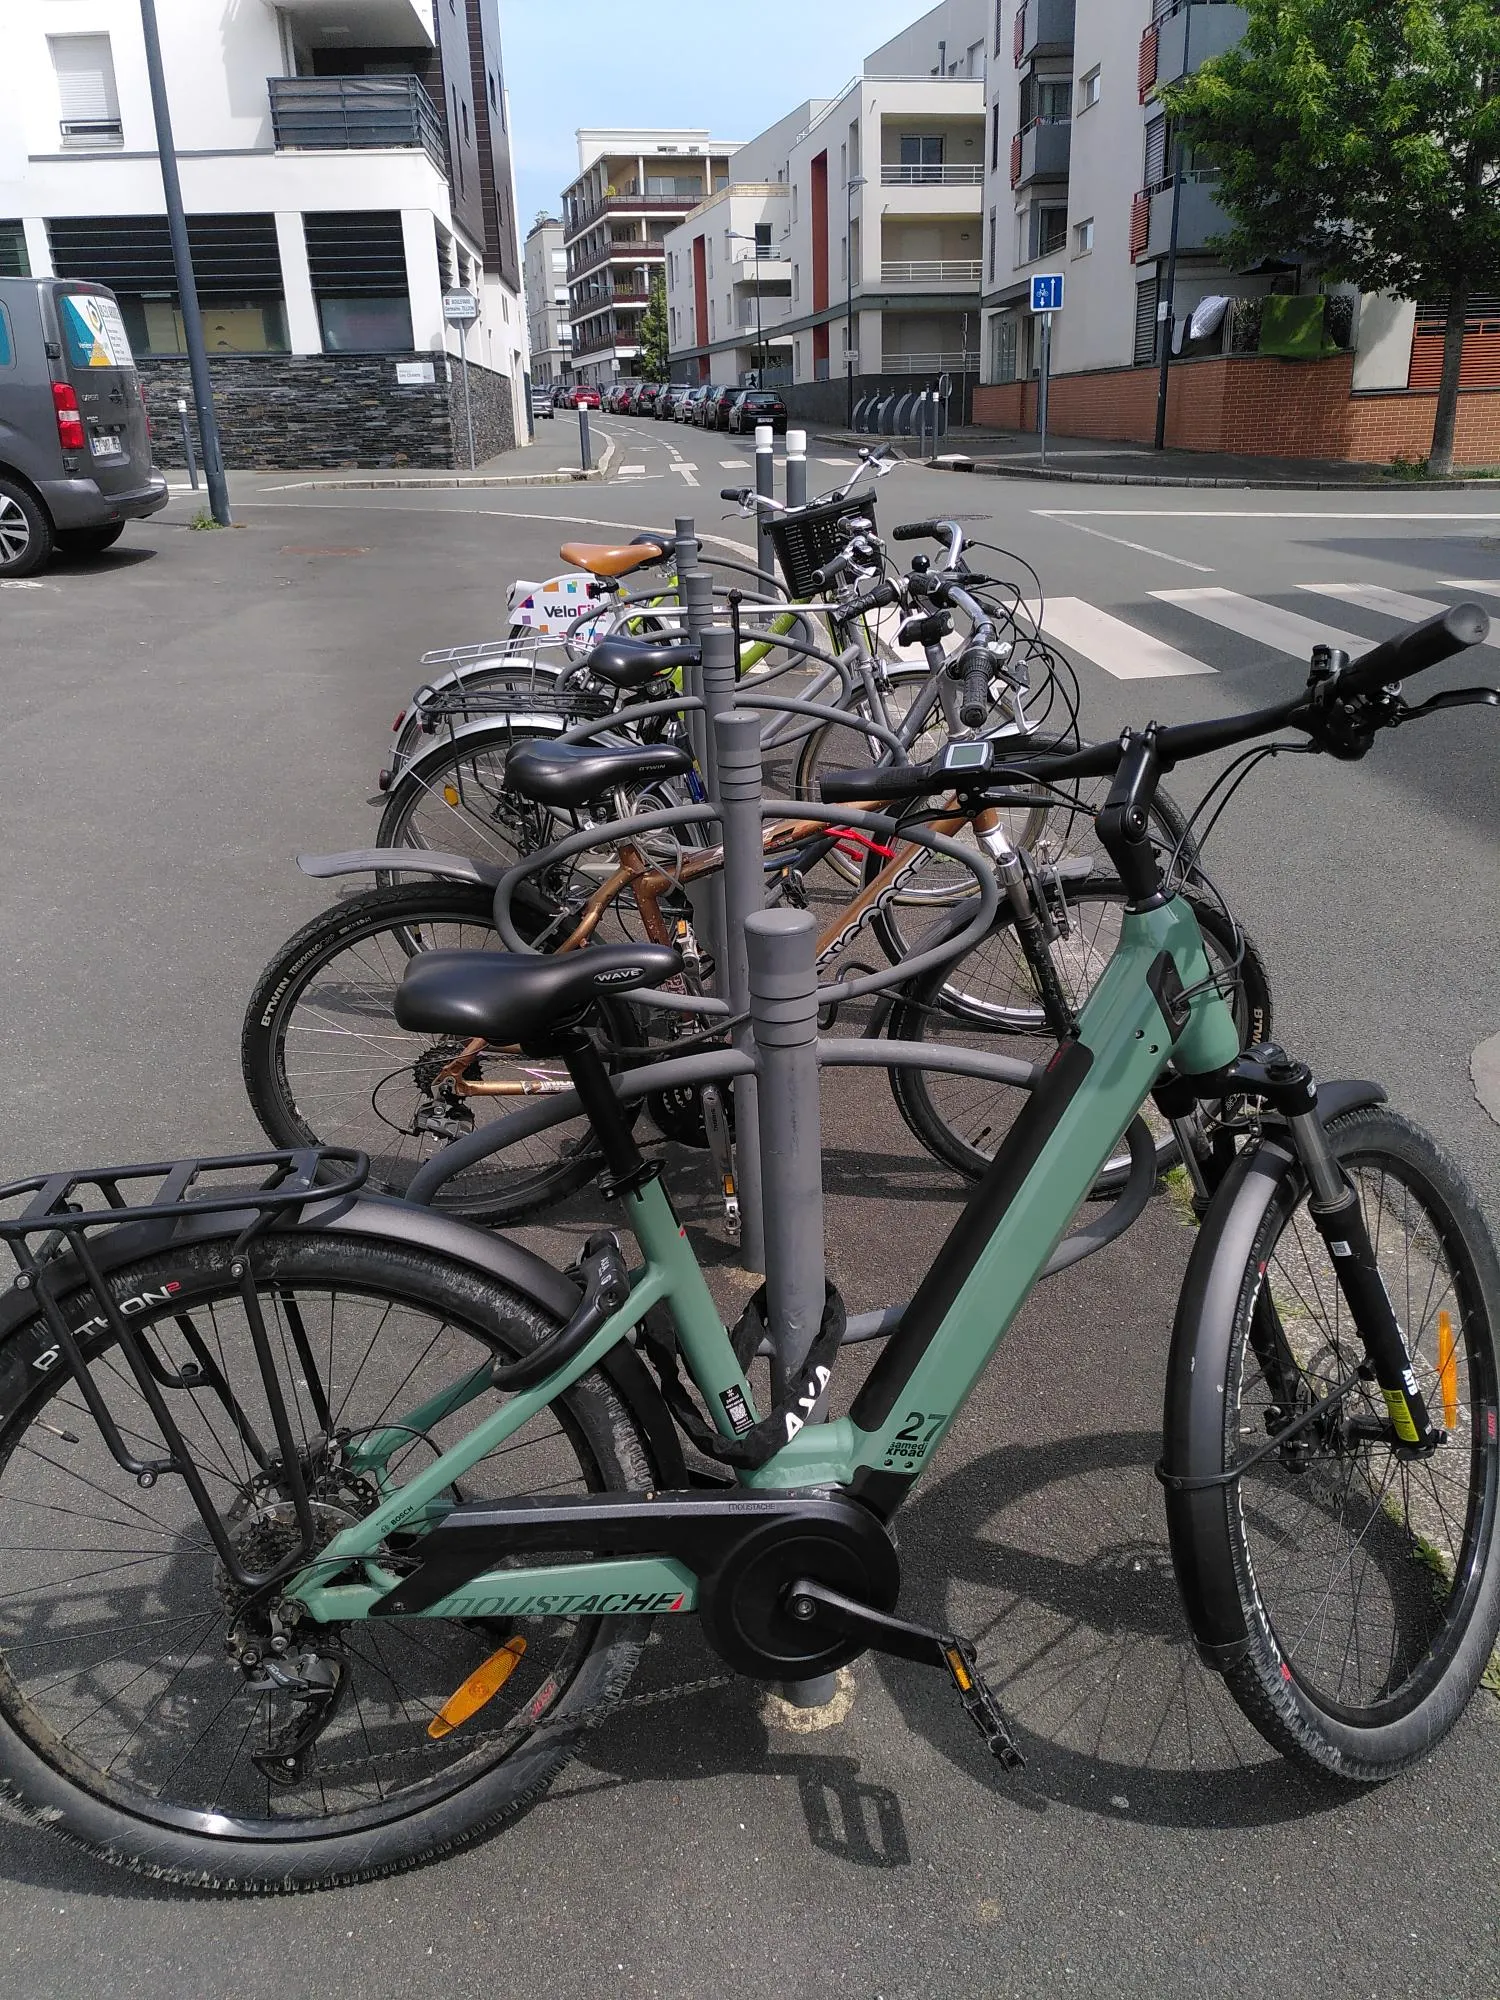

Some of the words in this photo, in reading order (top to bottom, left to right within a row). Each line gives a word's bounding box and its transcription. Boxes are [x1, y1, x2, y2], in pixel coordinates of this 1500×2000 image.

[598, 969, 641, 982] WAVE
[1402, 1368, 1418, 1396] ATB
[895, 1411, 949, 1442] 27
[885, 1446, 926, 1458] xroad
[889, 1441, 928, 1450] samedi
[390, 1505, 414, 1525] BOSCH
[440, 1592, 684, 1615] MOUSTACHE
